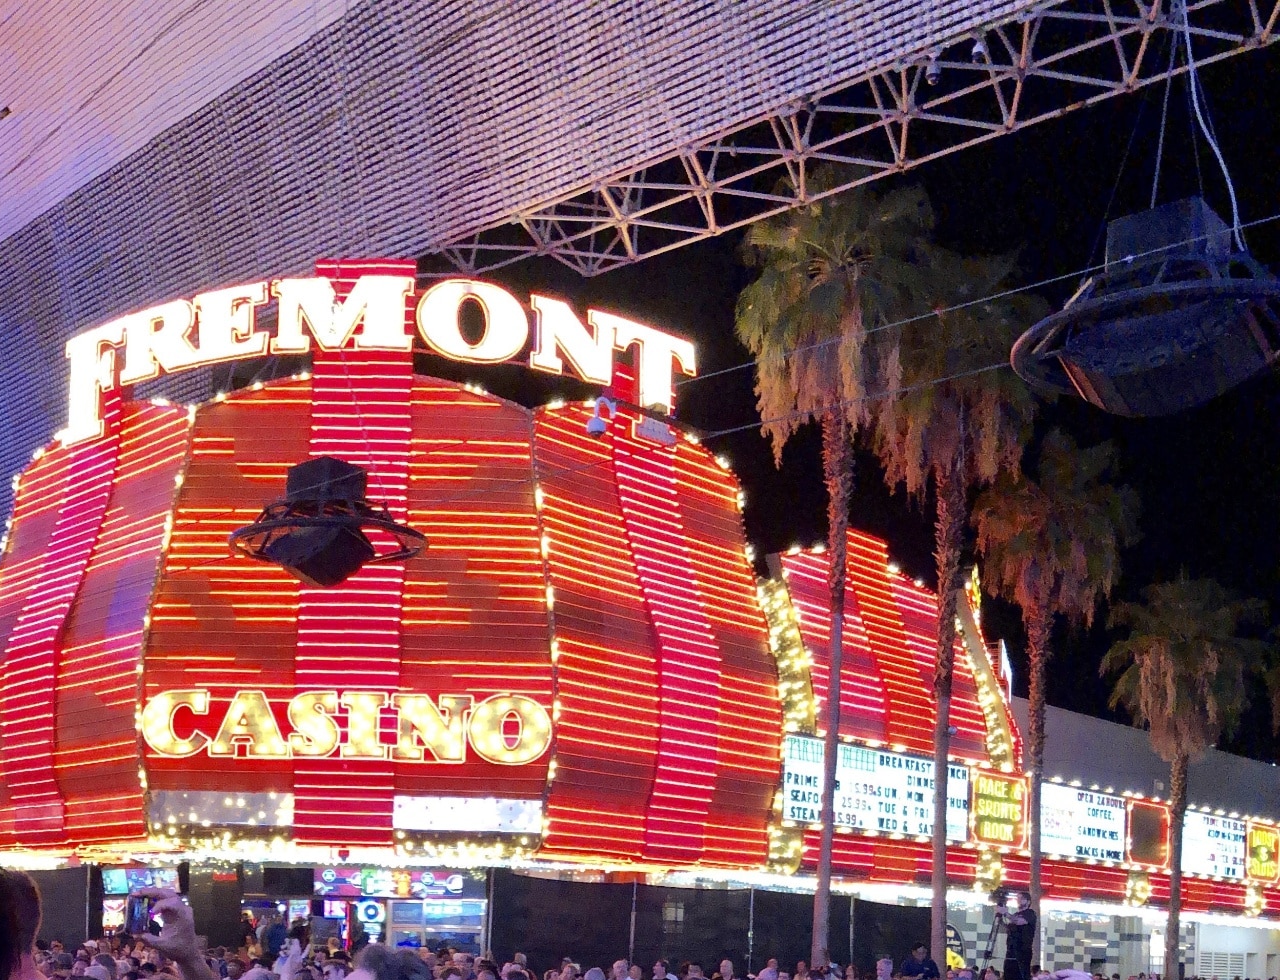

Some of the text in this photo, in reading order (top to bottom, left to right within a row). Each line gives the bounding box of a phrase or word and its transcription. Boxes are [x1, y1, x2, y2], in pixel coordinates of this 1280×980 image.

[59, 274, 697, 447] FREMONT
[141, 689, 553, 765] CASINO
[879, 755, 932, 774] BREAKFAST
[787, 772, 819, 788] PRIME
[907, 775, 934, 790] DINNE
[978, 777, 1009, 798] RACE
[790, 789, 822, 804] SEAFO
[1077, 792, 1094, 804] OPEN
[878, 801, 896, 815] TUE
[914, 808, 929, 819] FRI
[977, 799, 1022, 822] SPORTS
[877, 817, 898, 831] WED
[1075, 845, 1099, 857] SNACKS
